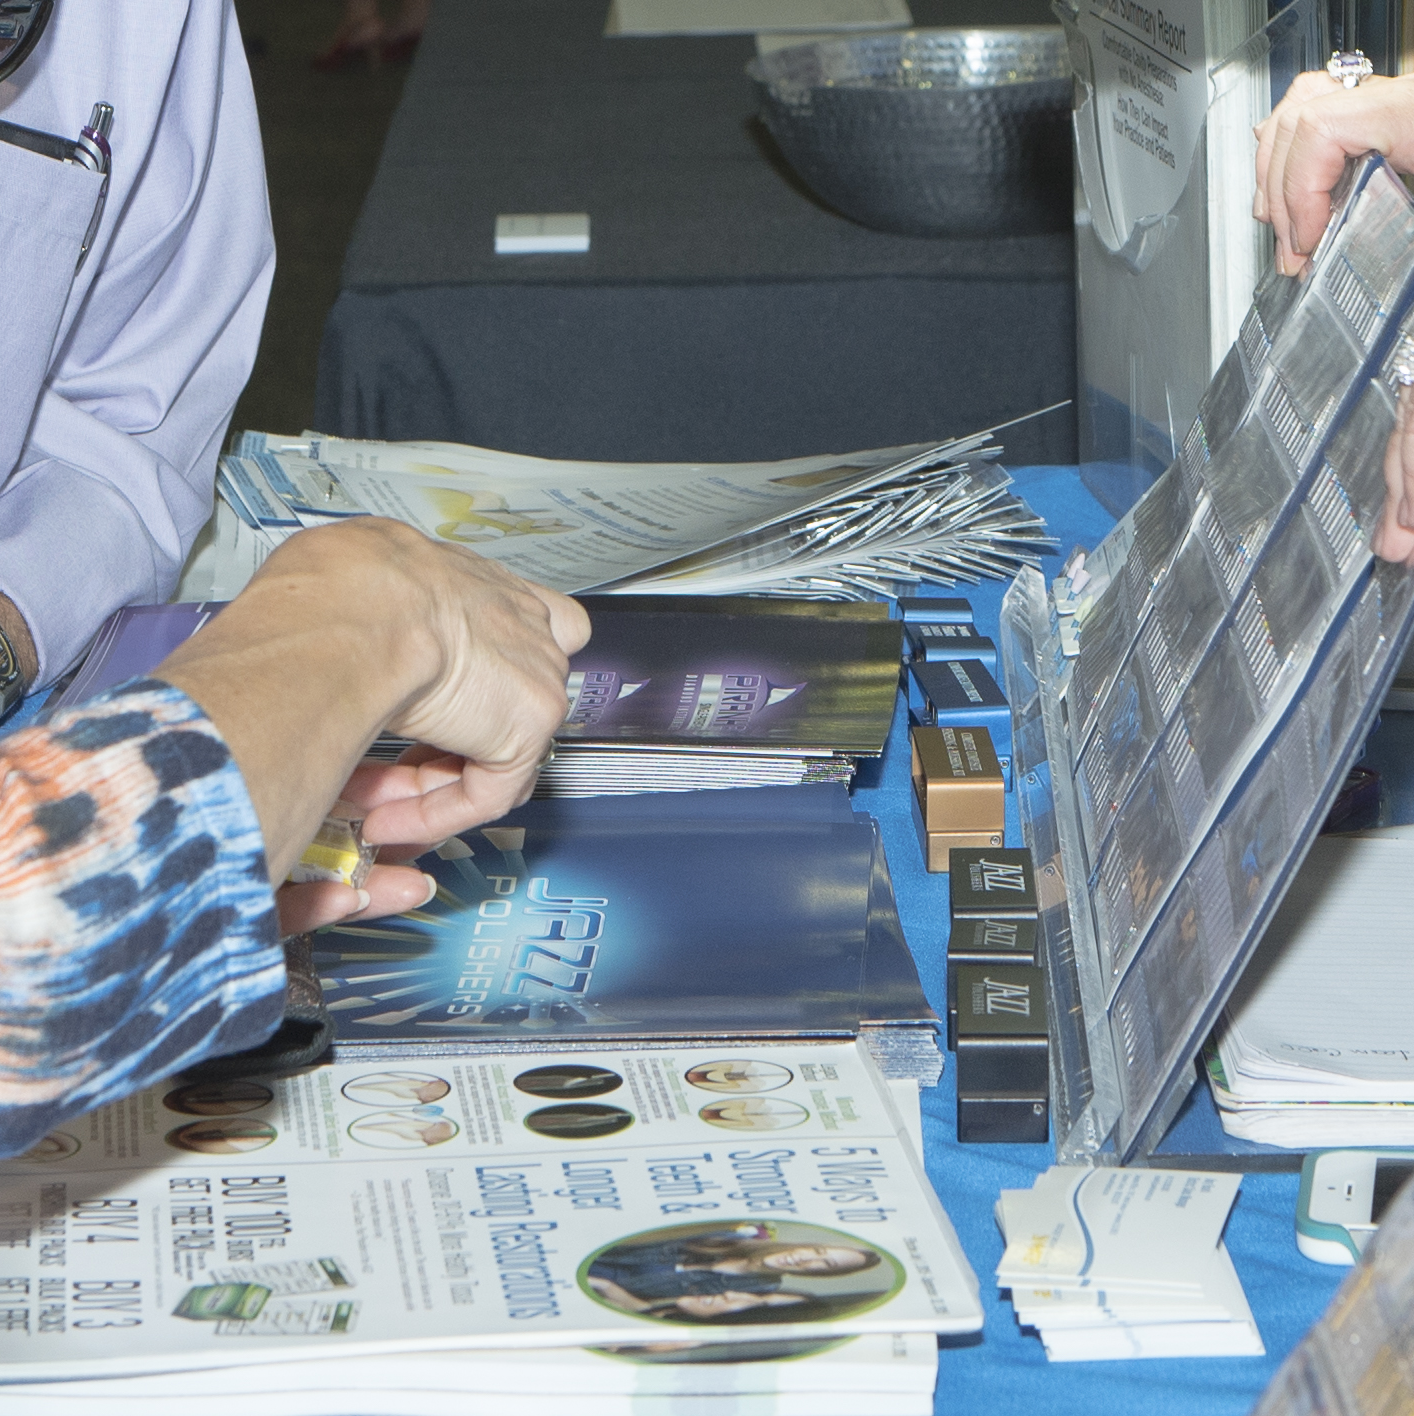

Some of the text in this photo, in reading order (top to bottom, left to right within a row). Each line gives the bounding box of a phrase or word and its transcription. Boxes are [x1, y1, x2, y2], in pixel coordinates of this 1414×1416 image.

[1157, 9, 1187, 55] Report
[980, 858, 1025, 892] JAZZ
[447, 875, 517, 1014] POLISHERS
[501, 877, 609, 995] JAZZ
[984, 919, 1018, 947] JAZZ
[984, 977, 1030, 1016] JAZZ
[170, 1177, 211, 1193] GET
[222, 1176, 288, 1205] BUY
[469, 1163, 548, 1218] Lasting
[553, 1158, 628, 1210] Longer
[645, 1152, 722, 1197] Teeth
[727, 1149, 798, 1214] Stronger
[811, 1147, 897, 1223] 5 Ways to
[72, 1199, 138, 1229] BUY
[171, 1206, 213, 1225] FREE
[225, 1211, 292, 1237] 100
[660, 1202, 720, 1214] &
[39, 1219, 66, 1235] BUR
[72, 1235, 139, 1243] 4
[172, 1229, 215, 1251] PACK
[39, 1238, 66, 1267] PACKS
[488, 1221, 573, 1319] Restorations
[39, 1278, 66, 1333] BULK PACKS
[72, 1280, 144, 1329] BUY 3
